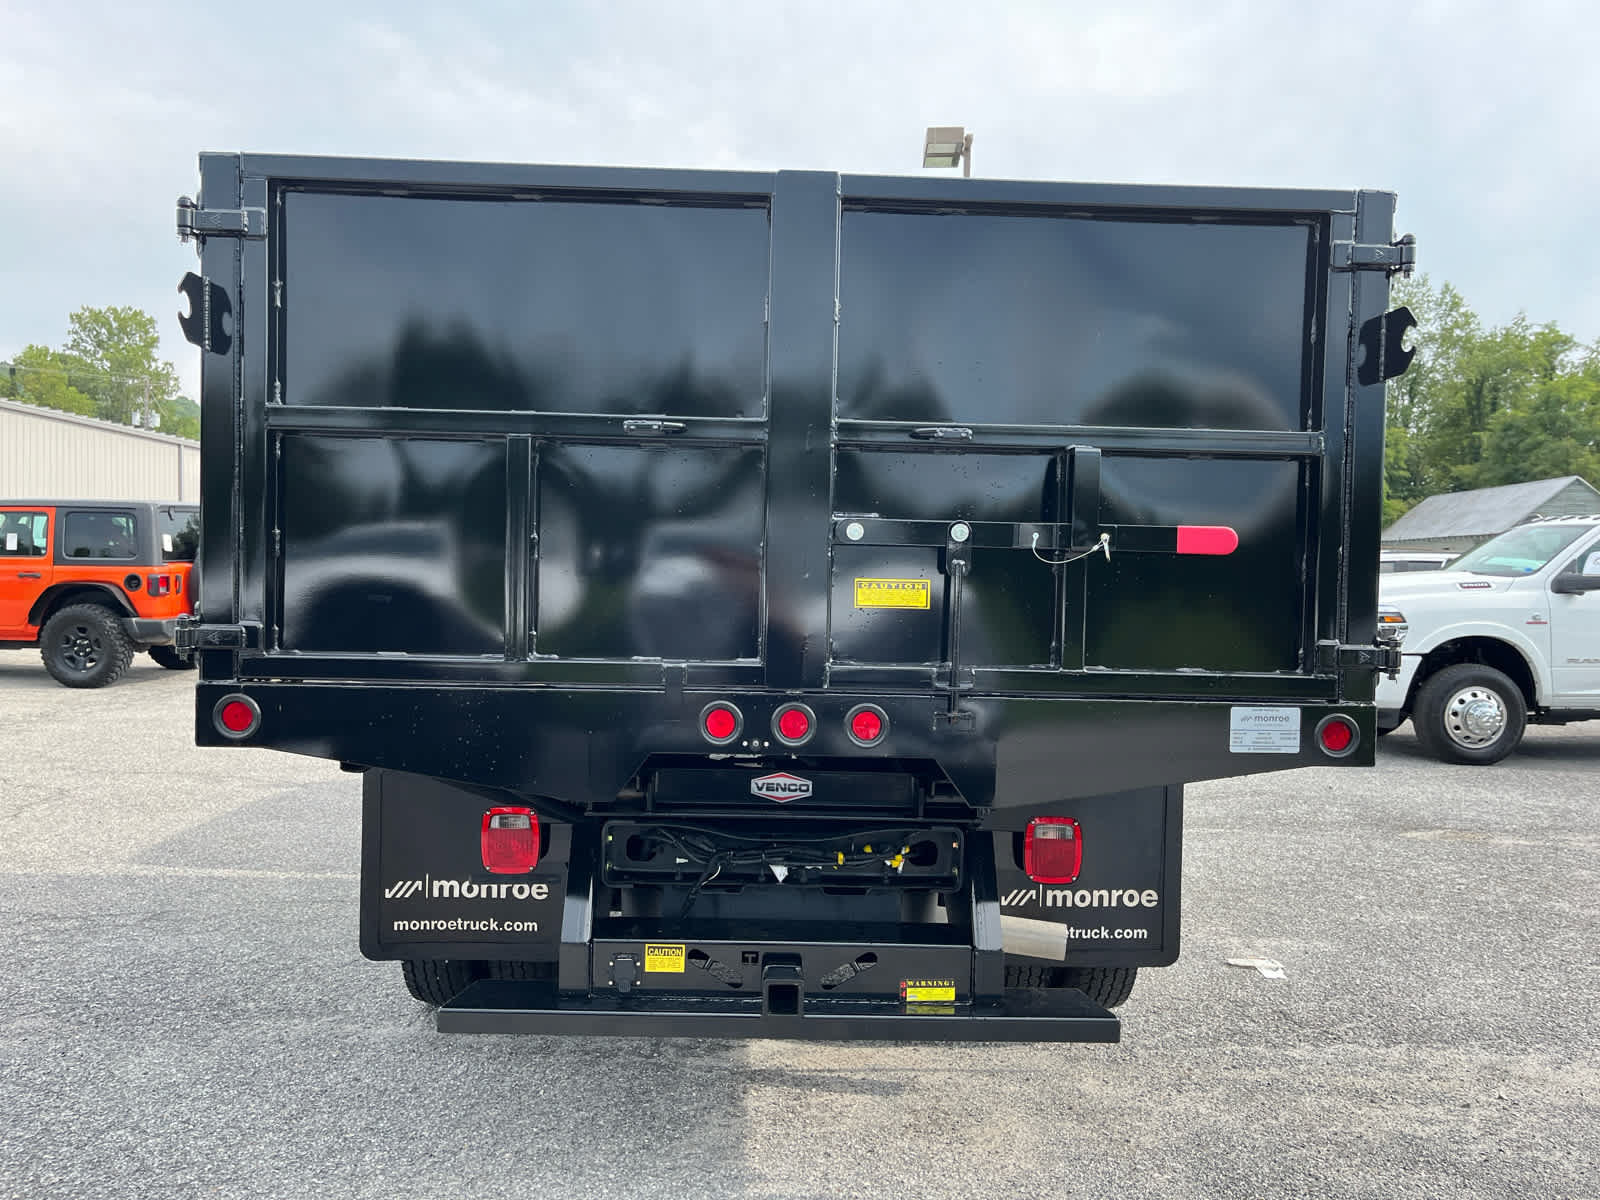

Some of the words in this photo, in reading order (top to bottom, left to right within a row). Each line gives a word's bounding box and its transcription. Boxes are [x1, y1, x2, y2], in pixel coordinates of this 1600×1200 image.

[755, 782, 810, 793] VENCO
[432, 879, 549, 900] monroe
[1046, 889, 1159, 908] monroe
[393, 918, 538, 932] monroetruck.com
[648, 948, 682, 956] CAUTION
